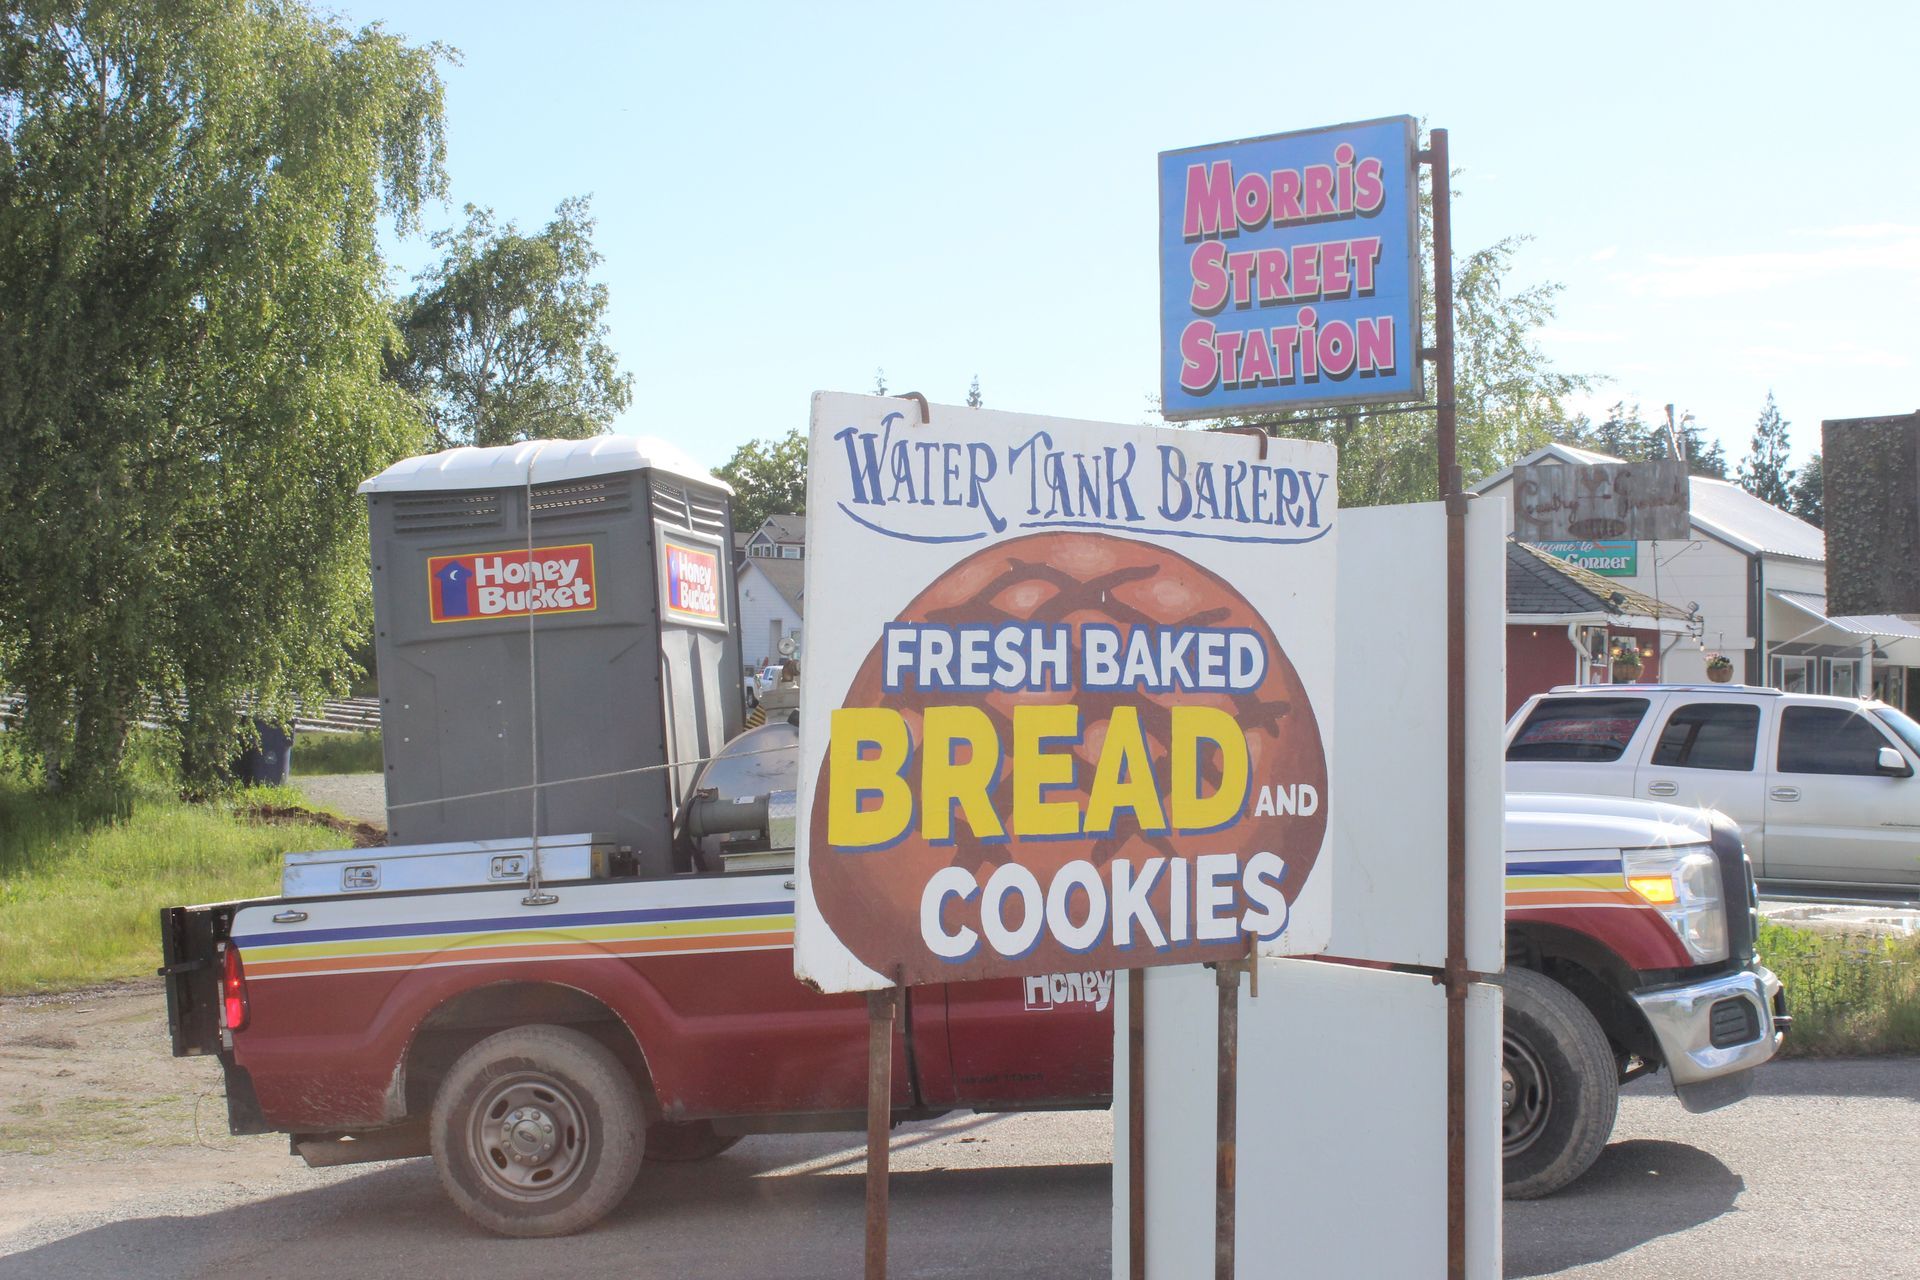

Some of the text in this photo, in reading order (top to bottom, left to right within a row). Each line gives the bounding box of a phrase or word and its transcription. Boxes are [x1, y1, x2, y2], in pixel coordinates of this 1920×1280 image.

[1189, 235, 1381, 313] STREET
[833, 411, 1329, 533] WATER TANK BAKERY
[1565, 553, 1630, 569] Conner
[1580, 541, 1593, 552] to
[475, 557, 579, 586] Honey
[679, 551, 711, 591] Honey
[478, 578, 590, 614] Bucket
[681, 581, 716, 612] Bucket
[883, 622, 1270, 693] FRESH BAKED
[828, 704, 1254, 850] BREAD
[1254, 783, 1319, 817] AND
[920, 851, 1290, 960] COOKIES
[1025, 969, 1113, 1012] Honey
